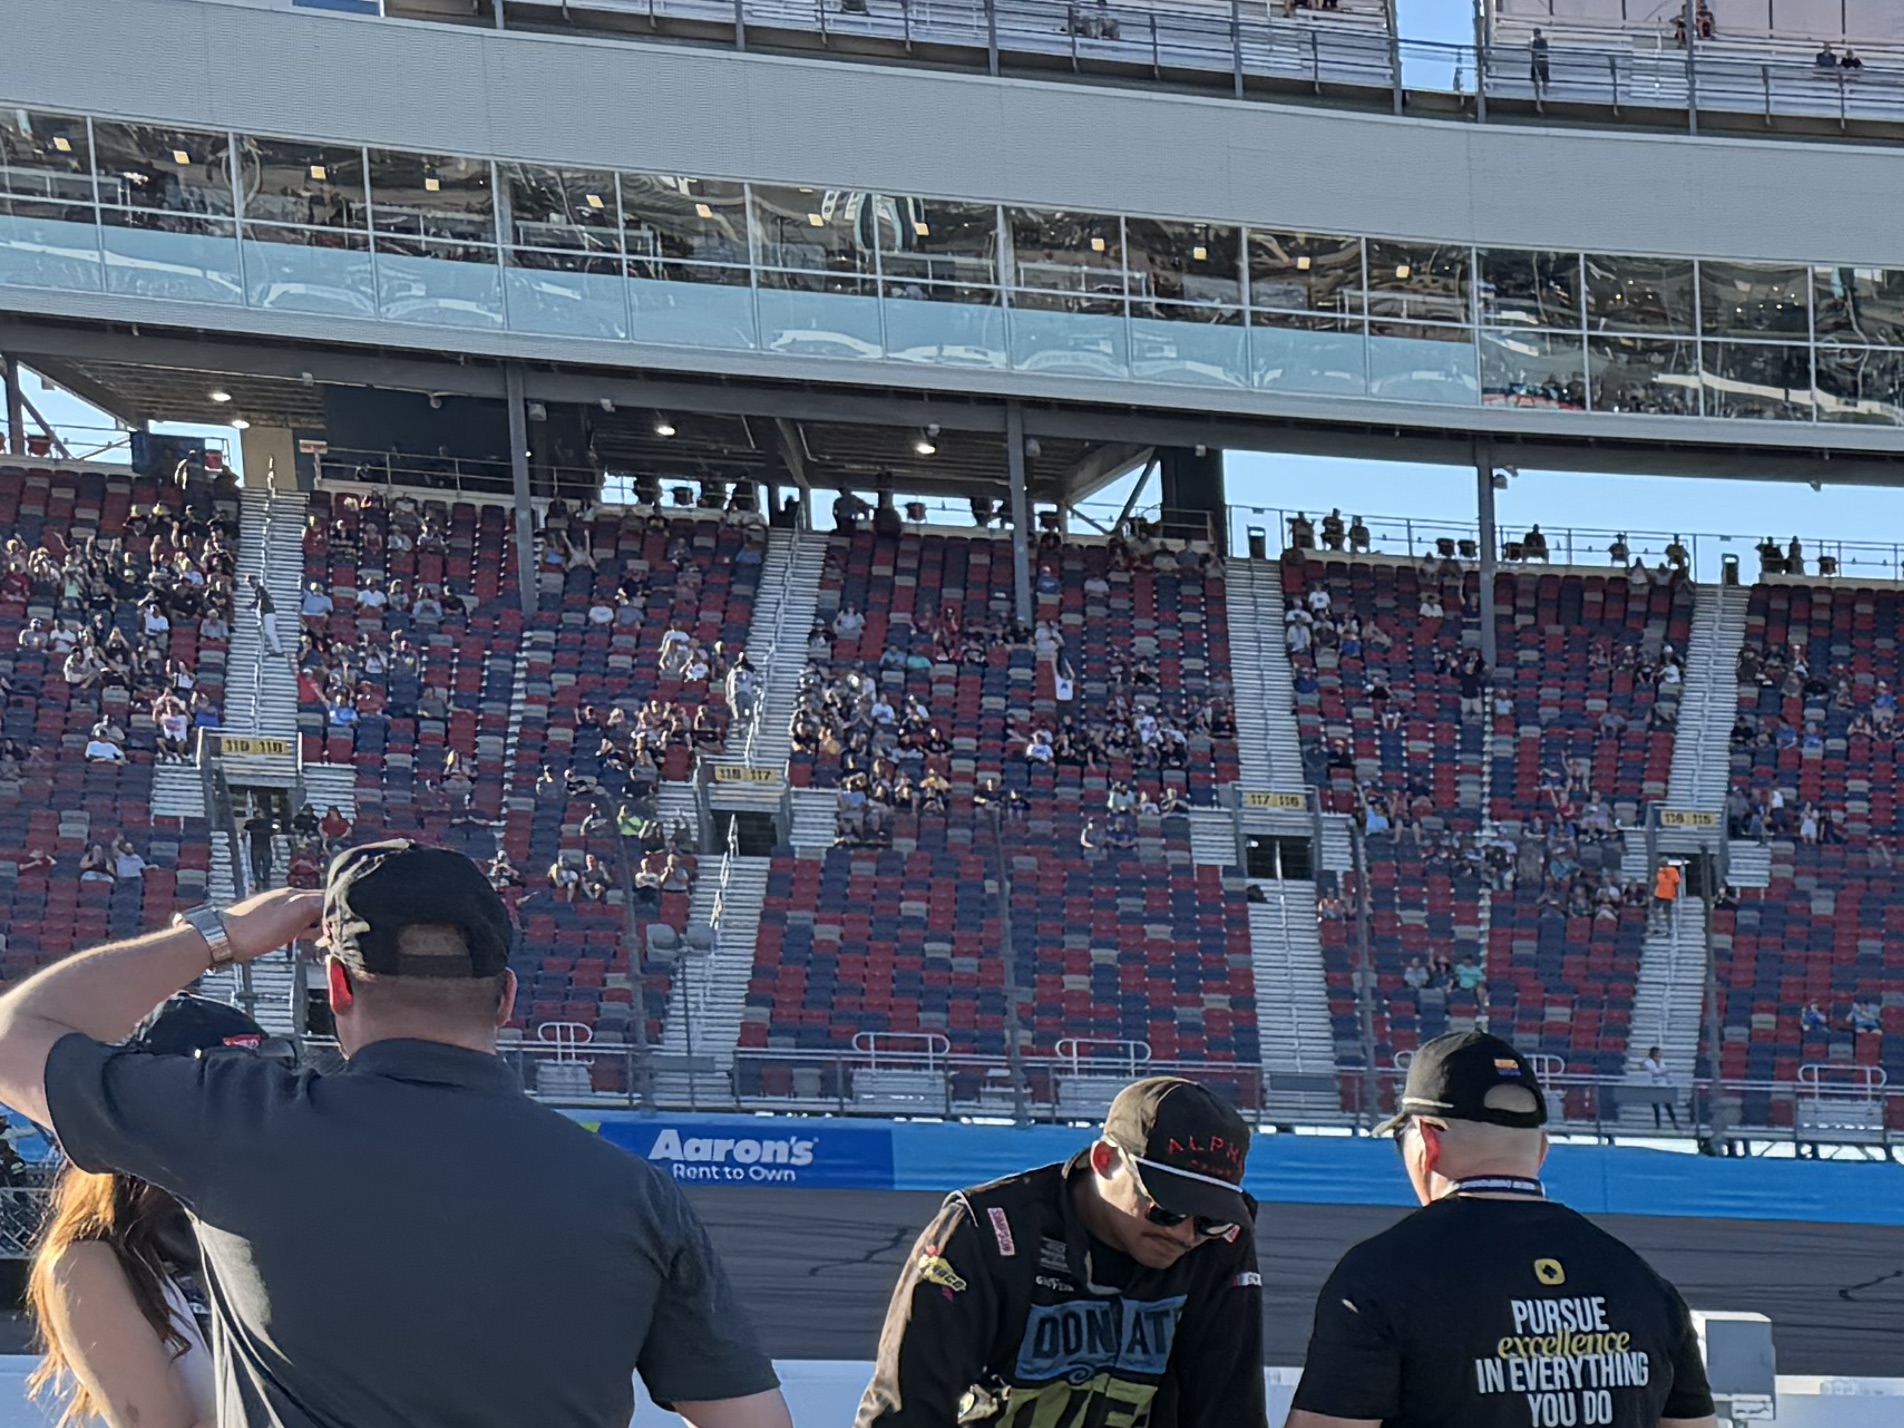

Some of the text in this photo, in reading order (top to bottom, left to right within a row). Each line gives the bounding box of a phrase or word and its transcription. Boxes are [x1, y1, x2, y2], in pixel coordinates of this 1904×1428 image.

[648, 1129, 814, 1166] Aaron's
[673, 1163, 796, 1181] Rent to Own
[1511, 1297, 1609, 1334] PURSUE
[1034, 1309, 1175, 1360] DONAT
[1498, 1328, 1629, 1359] excellence
[1475, 1351, 1649, 1393] IN EVERYTHING
[1527, 1390, 1613, 1428] YOU DO
